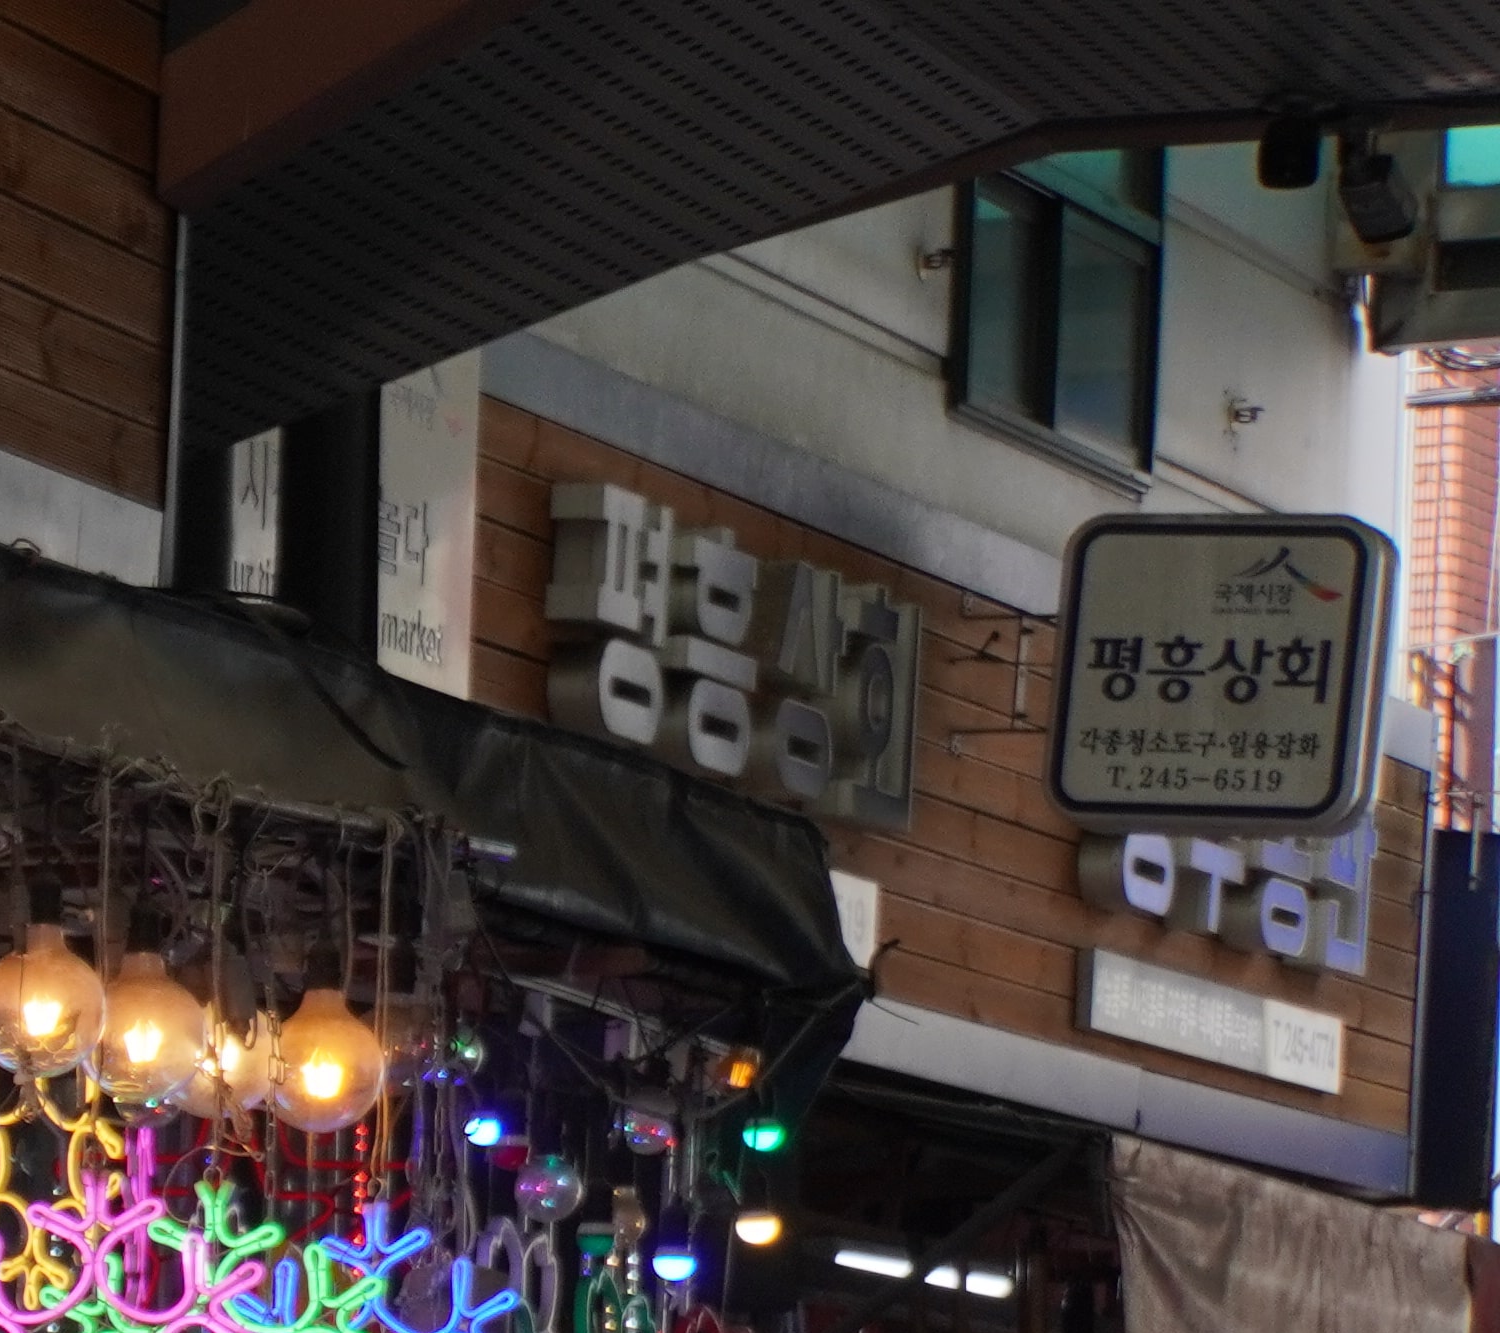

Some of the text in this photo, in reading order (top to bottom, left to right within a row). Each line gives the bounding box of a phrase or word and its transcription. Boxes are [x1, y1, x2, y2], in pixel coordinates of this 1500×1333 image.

[1213, 583, 1295, 606] 국제시장
[594, 483, 922, 833] 평흥상회
[1087, 635, 1331, 703] 평흥상회
[1106, 766, 1283, 792] T.245-6519
